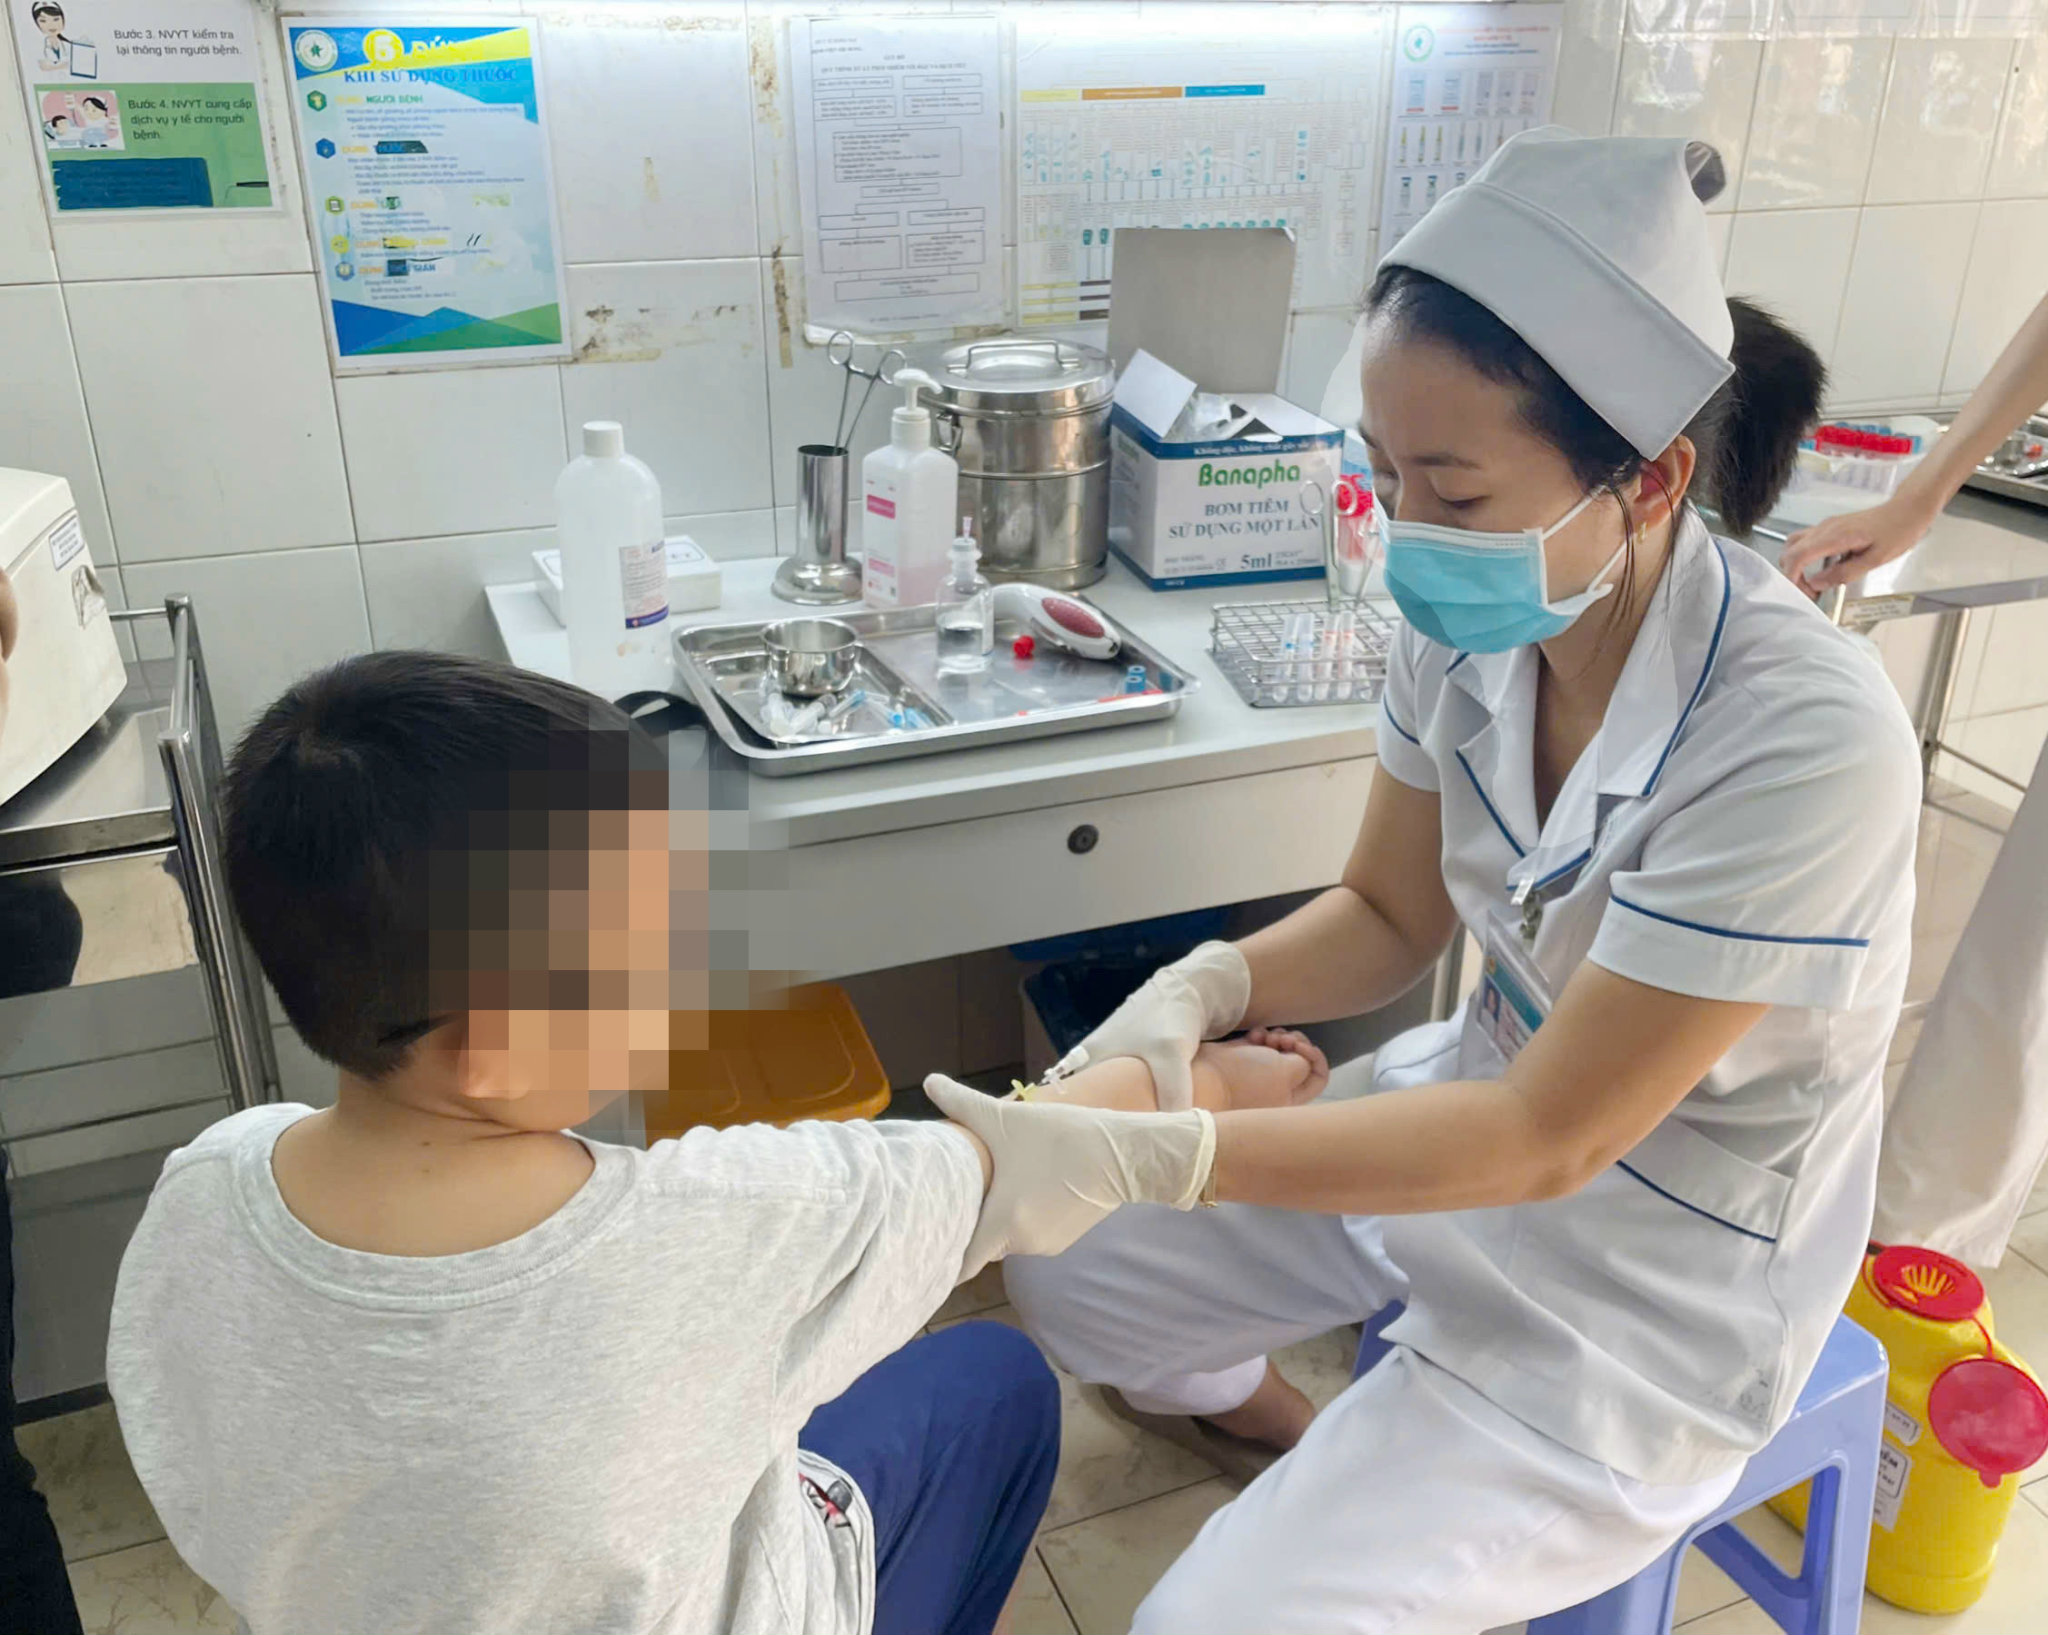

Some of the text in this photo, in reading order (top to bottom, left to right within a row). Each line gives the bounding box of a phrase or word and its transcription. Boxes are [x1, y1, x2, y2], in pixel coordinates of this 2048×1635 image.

[113, 29, 143, 40] Bước
[158, 29, 189, 40] NVYT
[192, 28, 218, 40] kiểm
[220, 30, 234, 40] tra
[116, 45, 130, 55] lại
[132, 45, 162, 57] thông
[164, 46, 177, 55] tin
[180, 46, 210, 57] người
[344, 70, 375, 83] KHI
[408, 70, 456, 85] DỤNG
[128, 98, 156, 110] Bước
[172, 98, 202, 109] NVYT
[205, 100, 230, 111] cung
[233, 98, 252, 110] cấp
[130, 115, 244, 126] dịch vụ y tế cho người
[1198, 458, 1301, 490] Banapha
[1205, 498, 1289, 516] BƠM TIÊM
[1195, 521, 1241, 539] DỤNG
[1246, 517, 1285, 536] MỘT
[1240, 553, 1273, 570] 5ml
